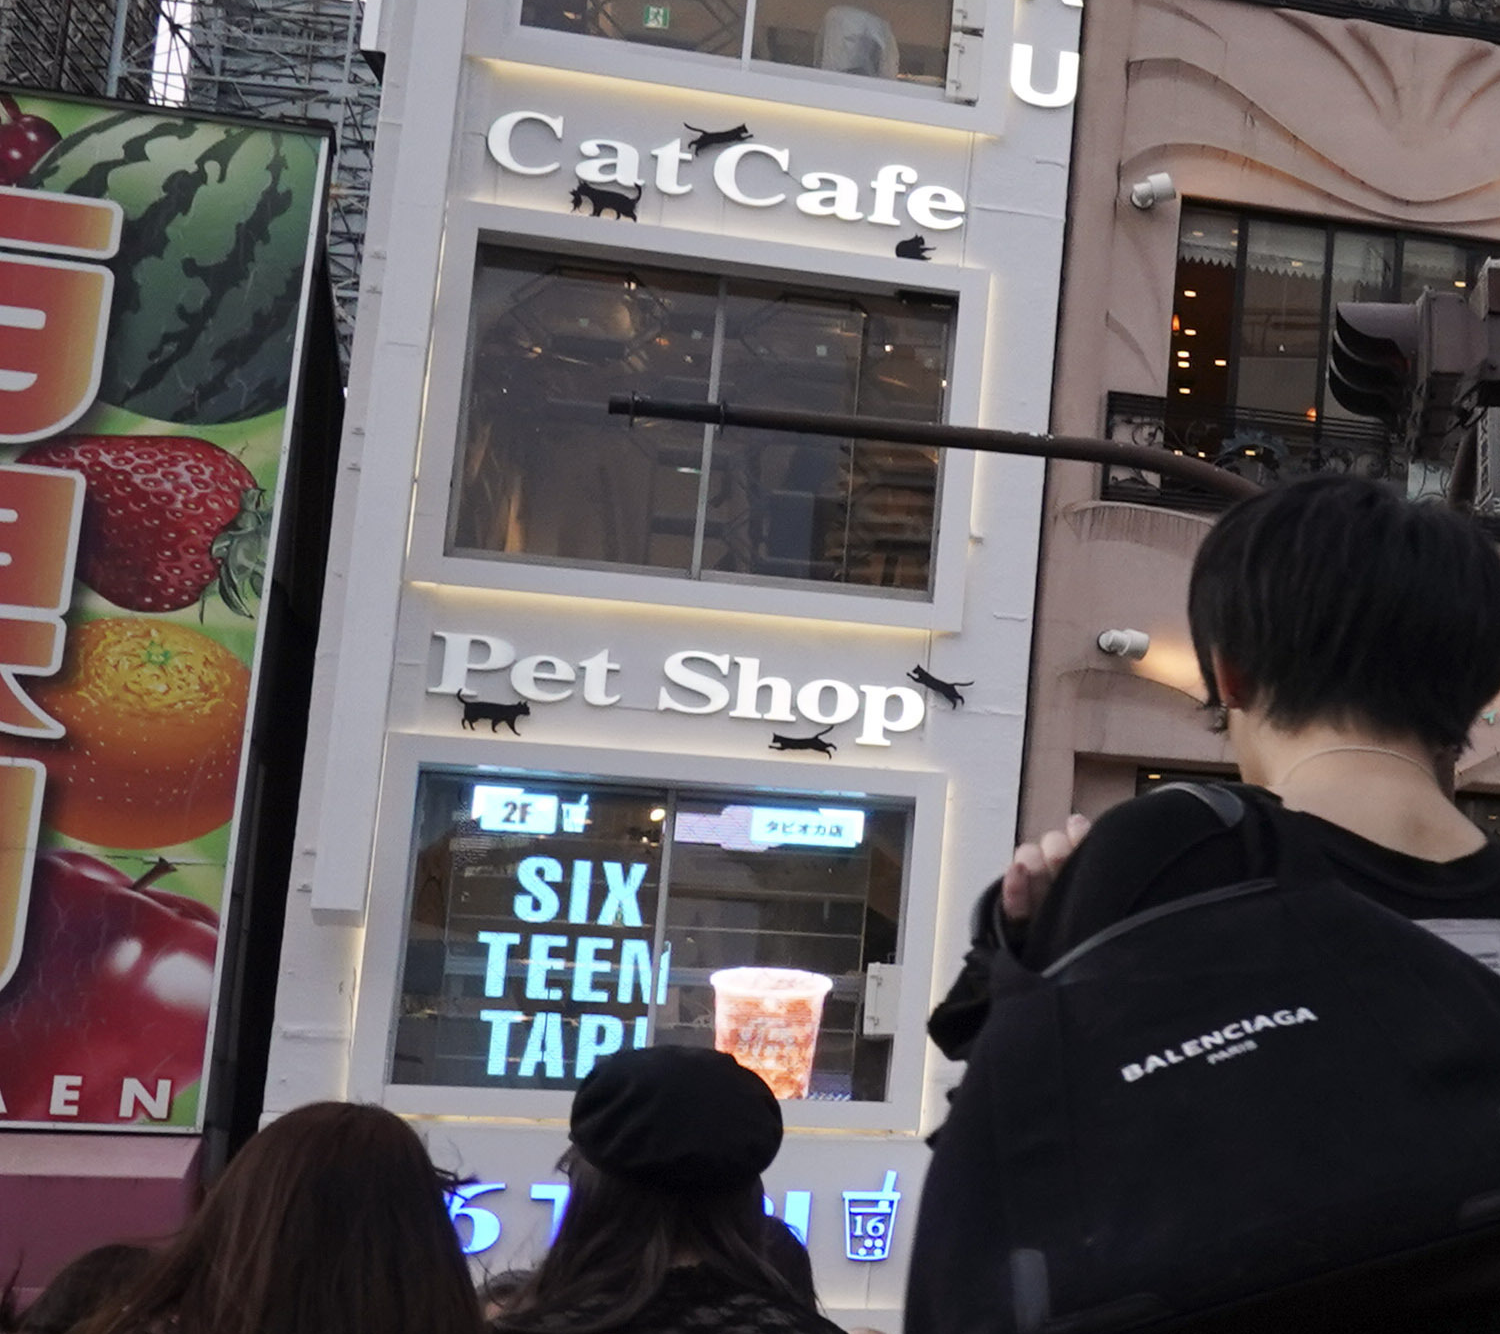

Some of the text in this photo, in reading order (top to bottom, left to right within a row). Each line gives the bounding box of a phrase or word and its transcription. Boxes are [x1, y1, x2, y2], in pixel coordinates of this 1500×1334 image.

[486, 109, 966, 231] Cat Cafe
[427, 631, 925, 747] Pet Shop
[502, 800, 533, 824] 2F
[513, 856, 648, 928] SIX
[479, 932, 671, 1005] TEEN
[1120, 1006, 1318, 1082] BALENCIAGA
[852, 1213, 887, 1238] 16
